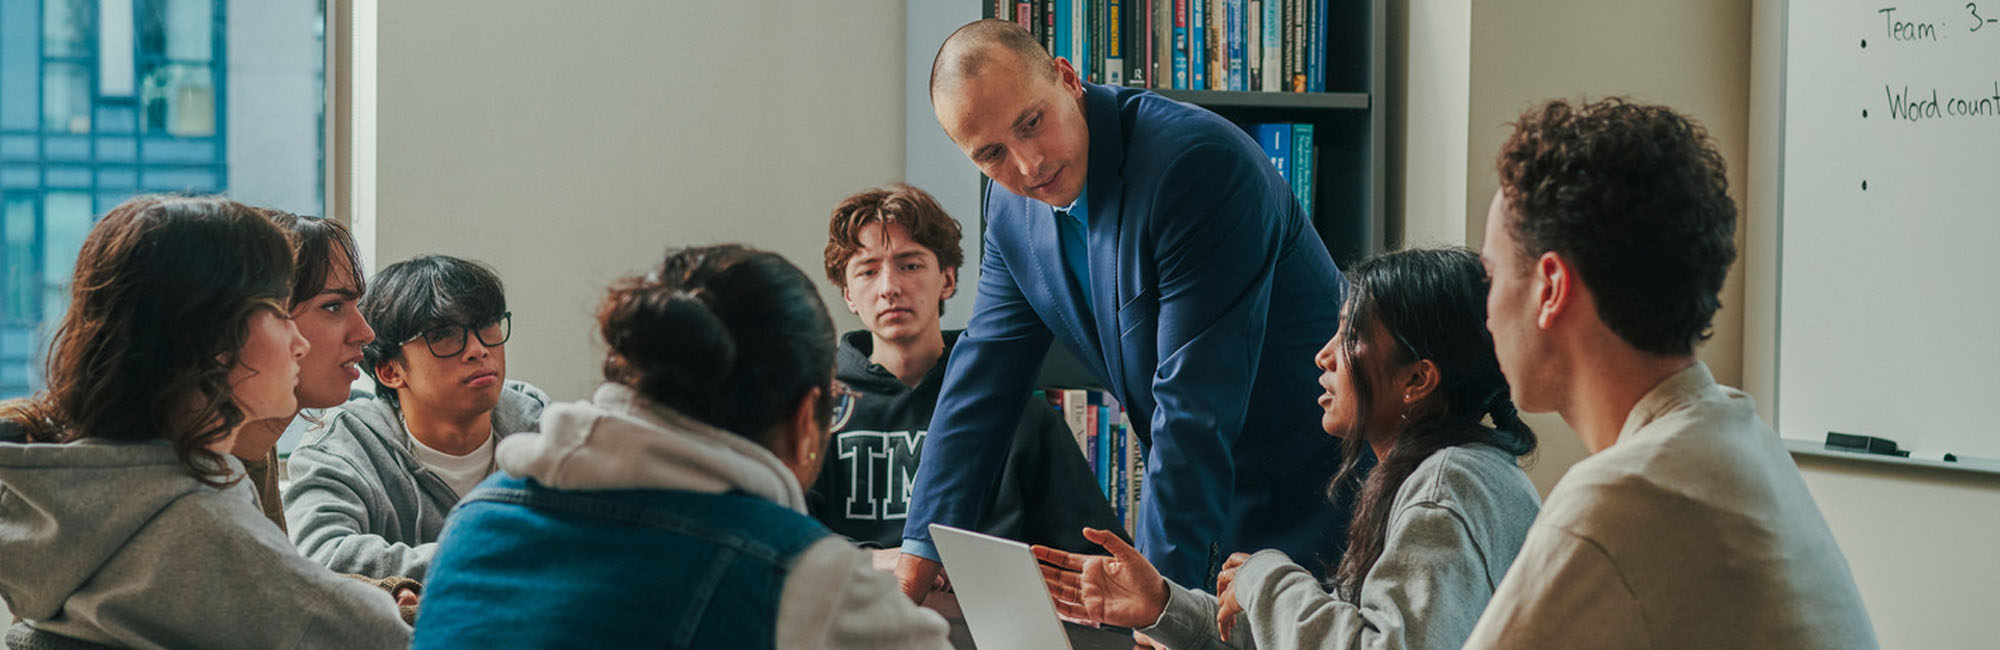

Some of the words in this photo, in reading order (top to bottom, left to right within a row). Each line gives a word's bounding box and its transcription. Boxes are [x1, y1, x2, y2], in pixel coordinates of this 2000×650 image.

[1878, 7, 1947, 42] Team:
[1885, 84, 1942, 122] Word
[1947, 80, 2000, 117] count
